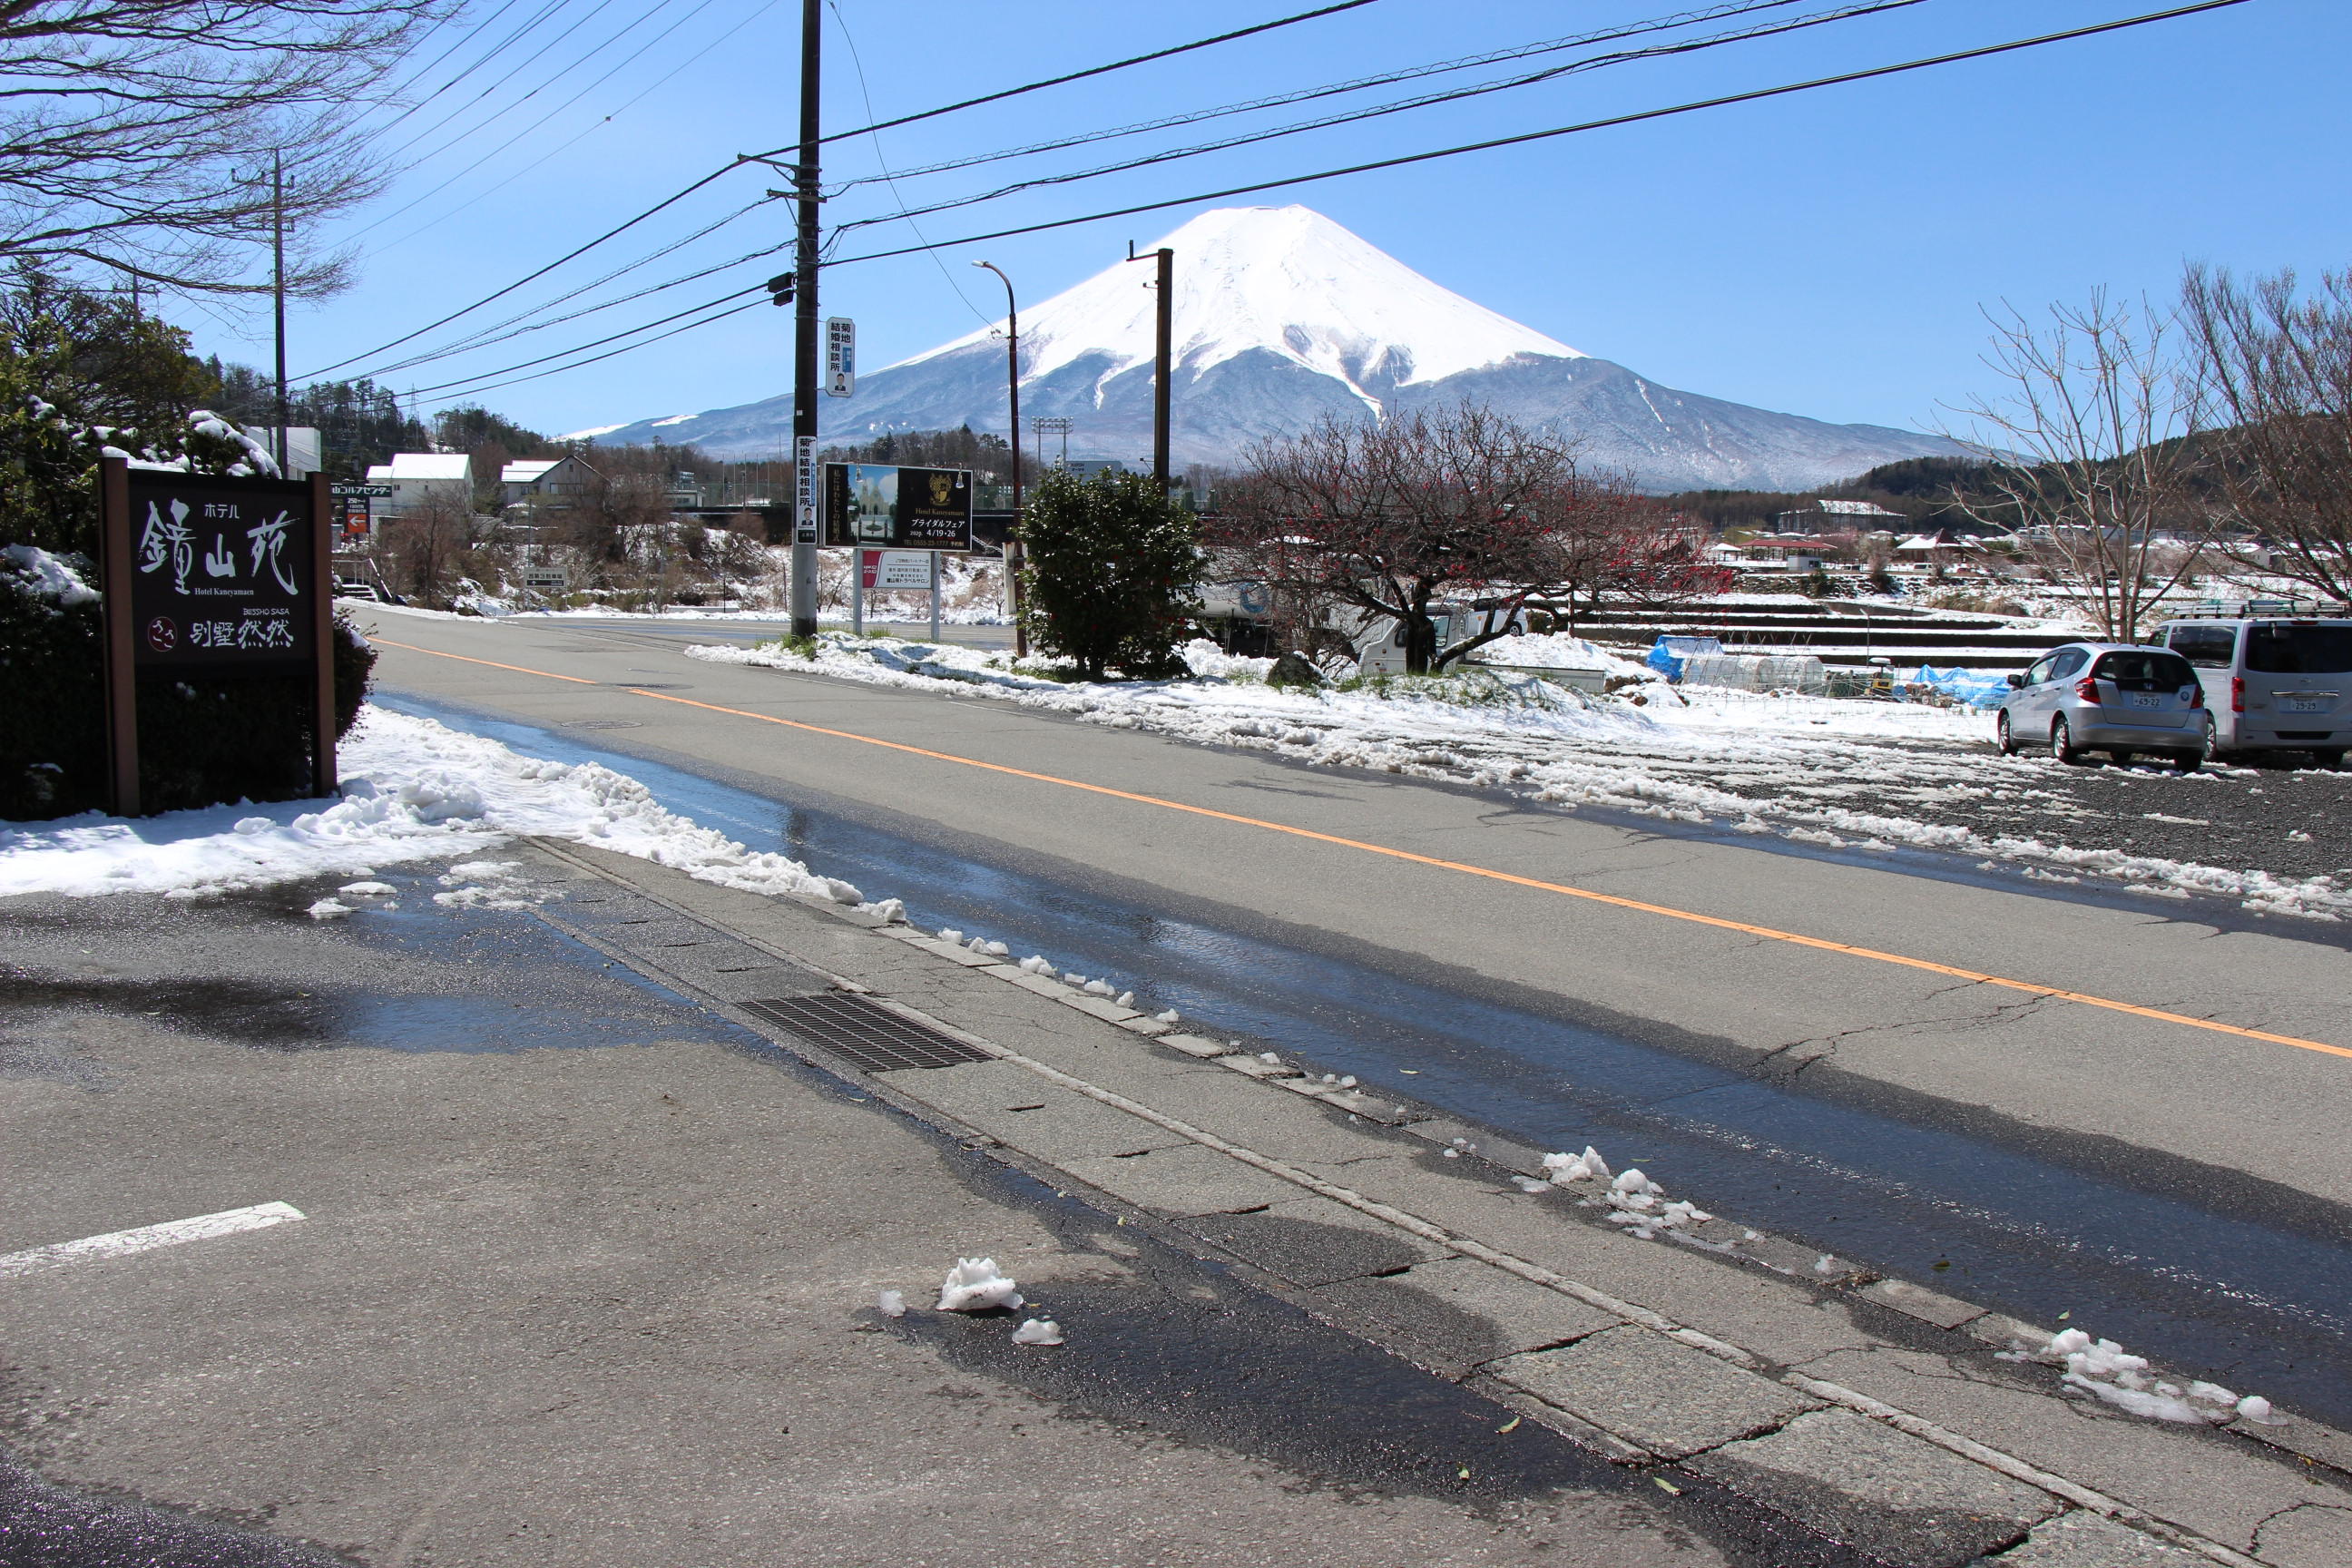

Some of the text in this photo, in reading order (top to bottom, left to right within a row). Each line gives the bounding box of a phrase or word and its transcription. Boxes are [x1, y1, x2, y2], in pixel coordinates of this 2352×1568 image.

[840, 324, 851, 344] 菊地
[830, 322, 840, 372] 結婚相談所
[799, 438, 810, 507] 菊地結婚相談所
[204, 504, 240, 519] ホテル
[911, 518, 965, 529] ブライダルフェア
[138, 498, 302, 595] 鐘山苑
[194, 587, 213, 596] Hotel
[242, 607, 290, 616] BESSHO SASA
[189, 619, 295, 650] 別墅然然
